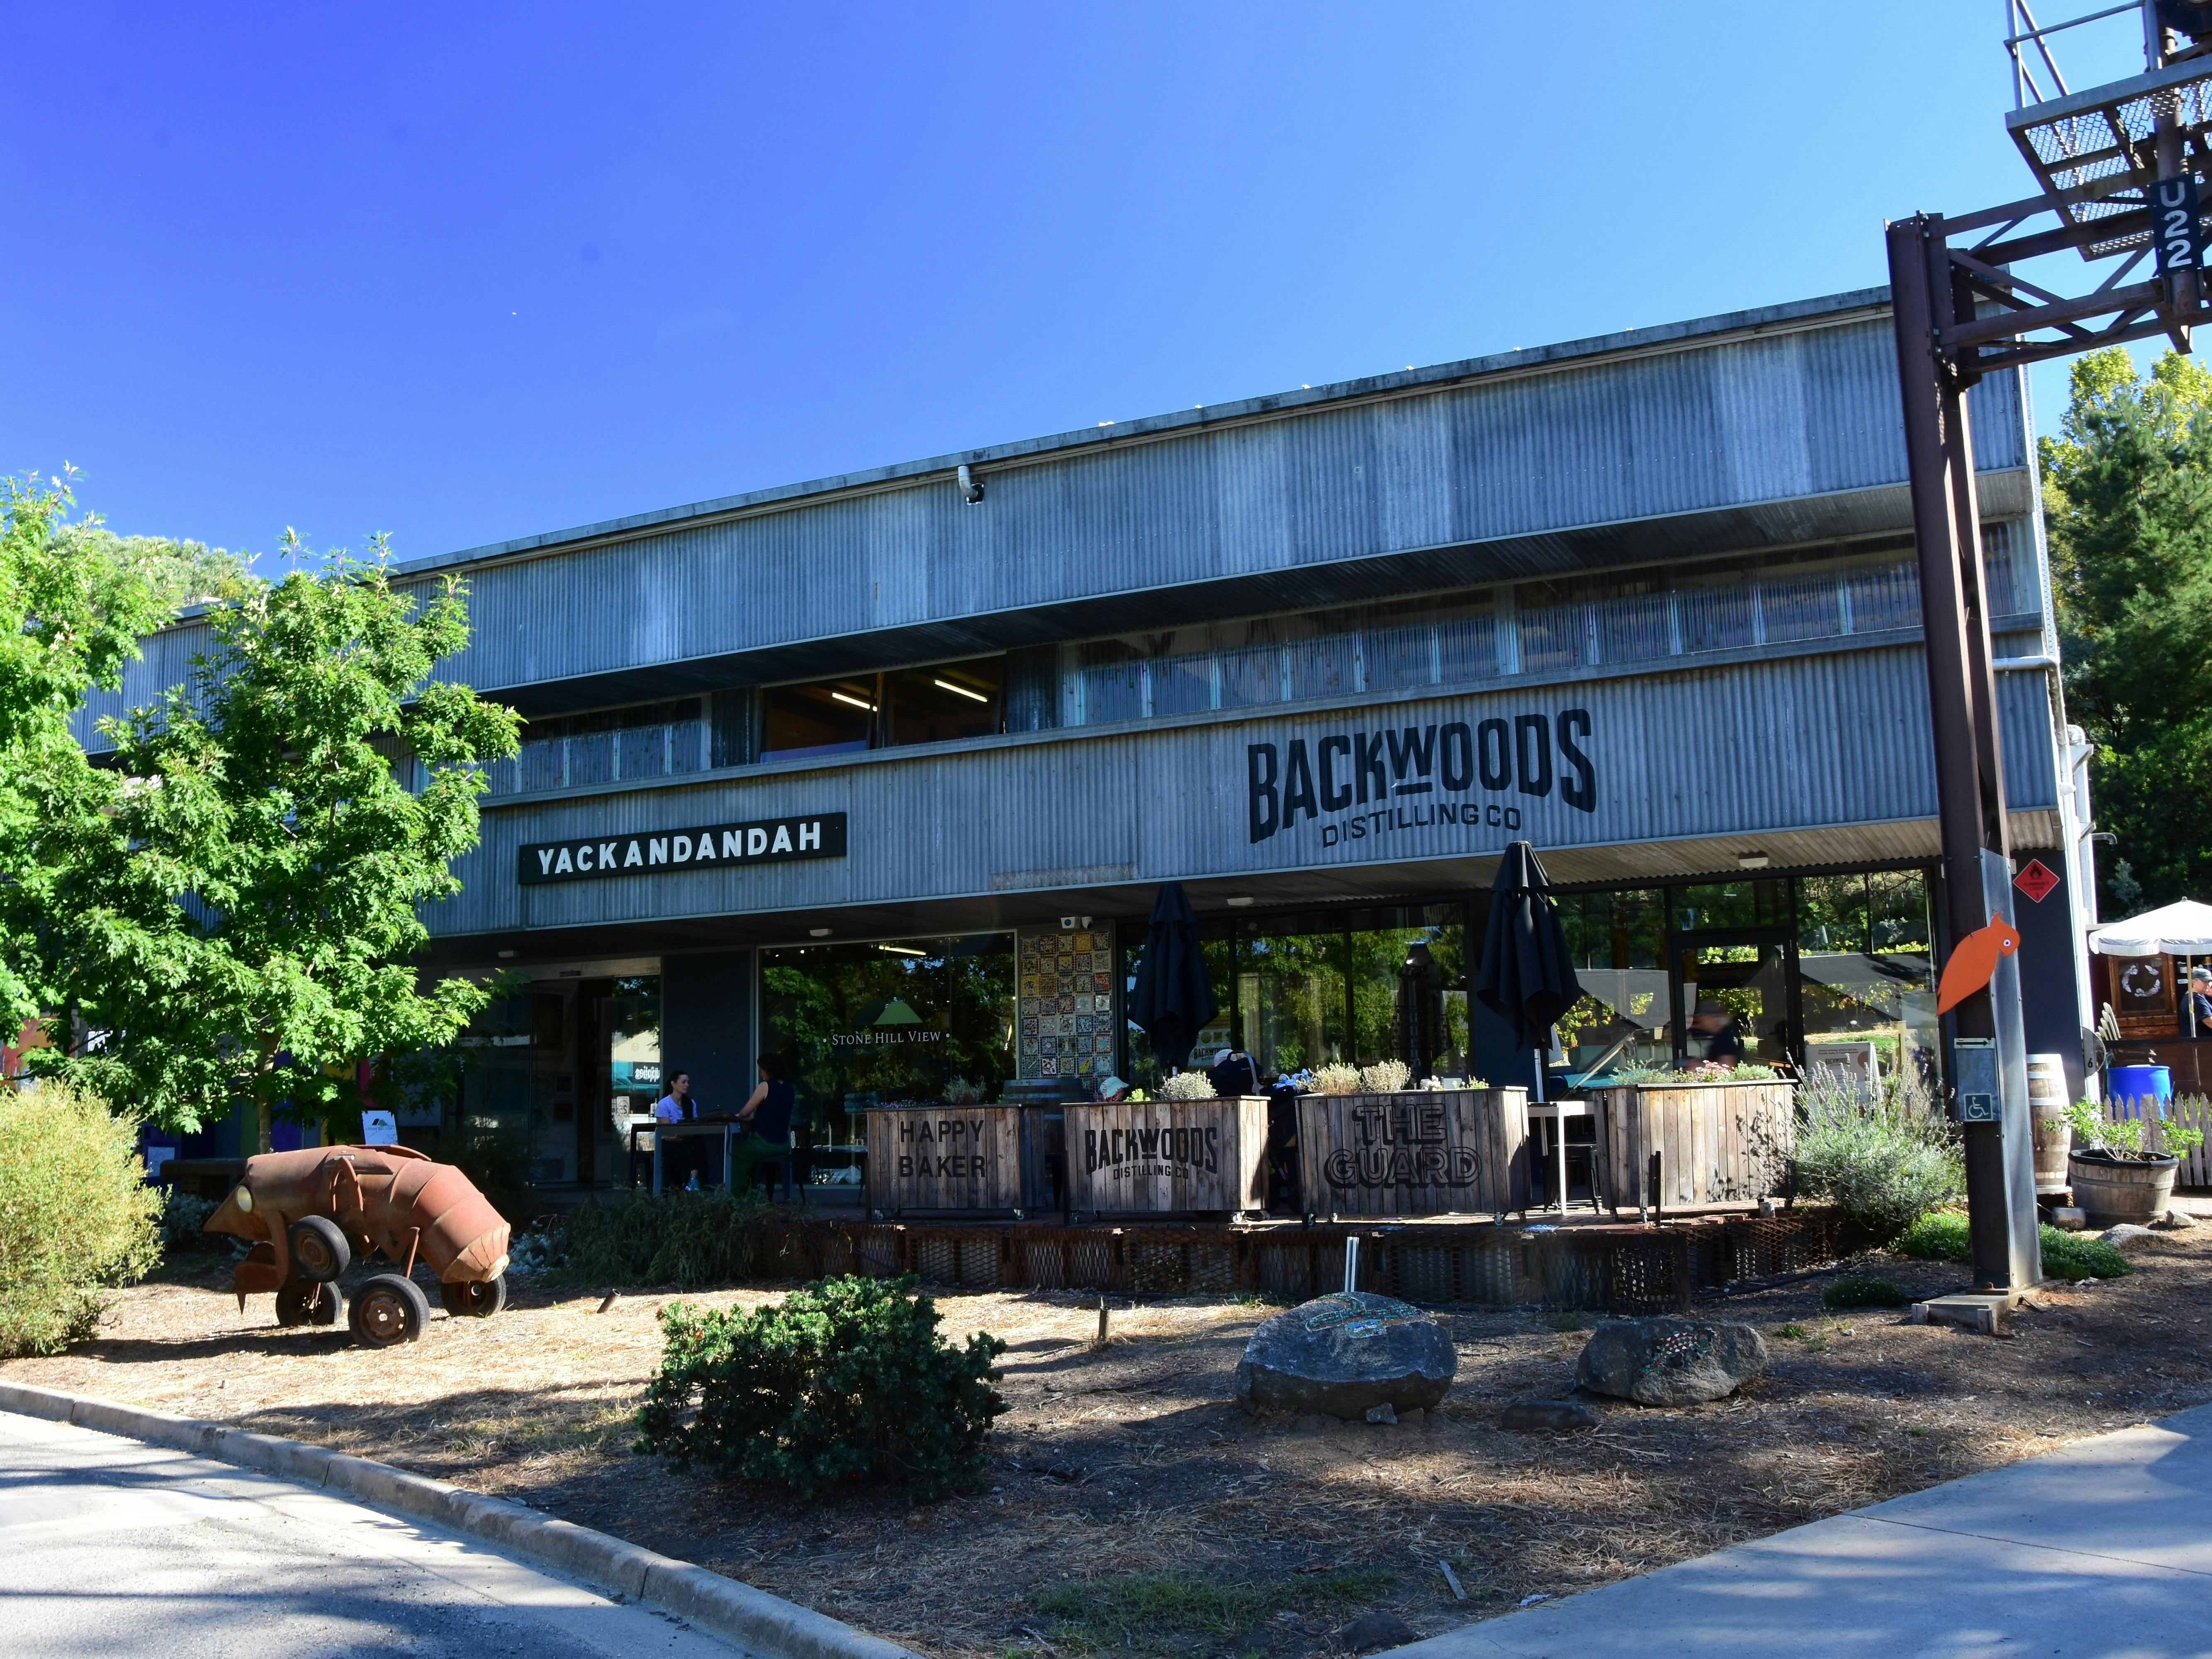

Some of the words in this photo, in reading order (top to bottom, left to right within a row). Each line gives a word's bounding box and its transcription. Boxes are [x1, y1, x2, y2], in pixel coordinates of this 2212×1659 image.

[1247, 708, 1597, 844] BACKWOODS
[1323, 803, 1479, 848] DISTILLING
[1487, 805, 1521, 830] CO
[538, 822, 820, 875] YACKANDANDAH
[832, 1034, 871, 1045] STONE
[875, 1032, 904, 1044] HILL
[908, 1031, 941, 1042] VIEW
[1194, 1046, 1230, 1061] BACKWO
[2088, 1057, 2093, 1068] 6
[900, 1120, 984, 1142] HAPPY
[1351, 1103, 1446, 1146] THE
[900, 1155, 986, 1177] BAKER
[1085, 1127, 1217, 1175] BACKWOODS
[1113, 1165, 1171, 1180] DISTILLING
[1175, 1166, 1189, 1179] CO
[1324, 1146, 1482, 1189] GUARD
